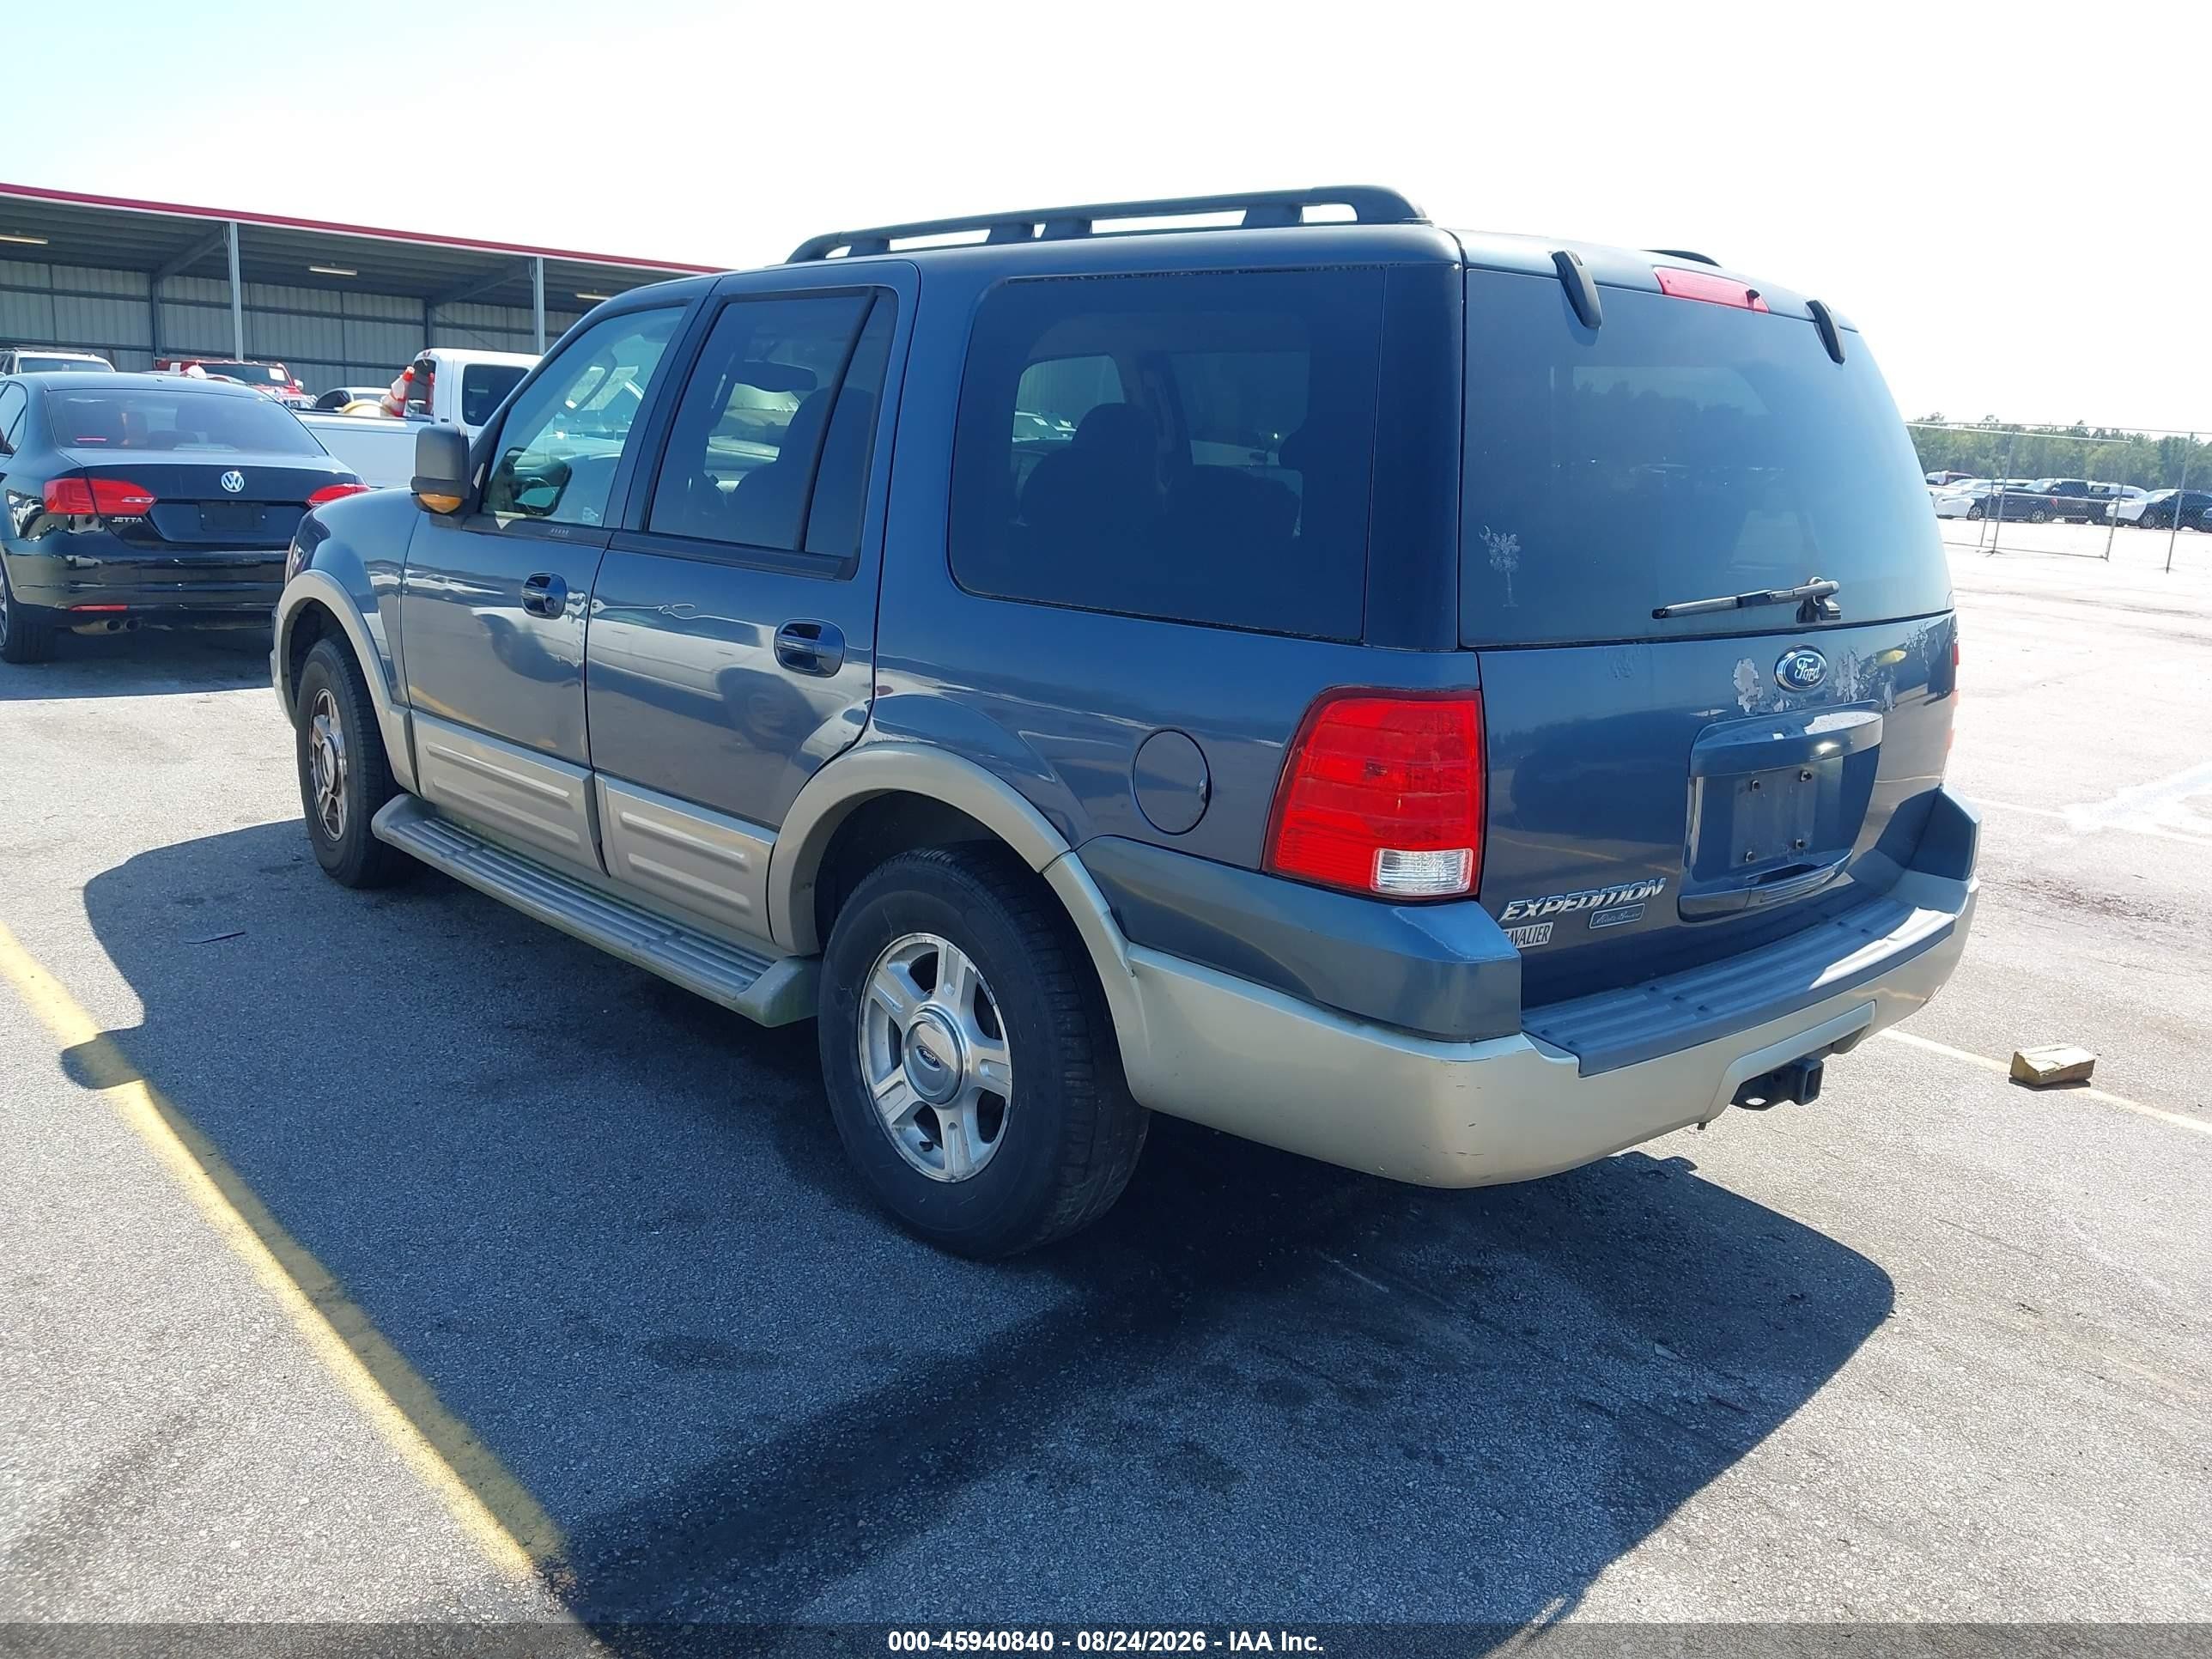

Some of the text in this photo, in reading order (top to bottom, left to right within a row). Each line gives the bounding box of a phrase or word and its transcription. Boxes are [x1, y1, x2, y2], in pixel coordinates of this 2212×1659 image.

[1794, 657, 1821, 682] Ford
[1498, 877, 1667, 923] EXPEDITION
[1504, 924, 1551, 947] AVALIER
